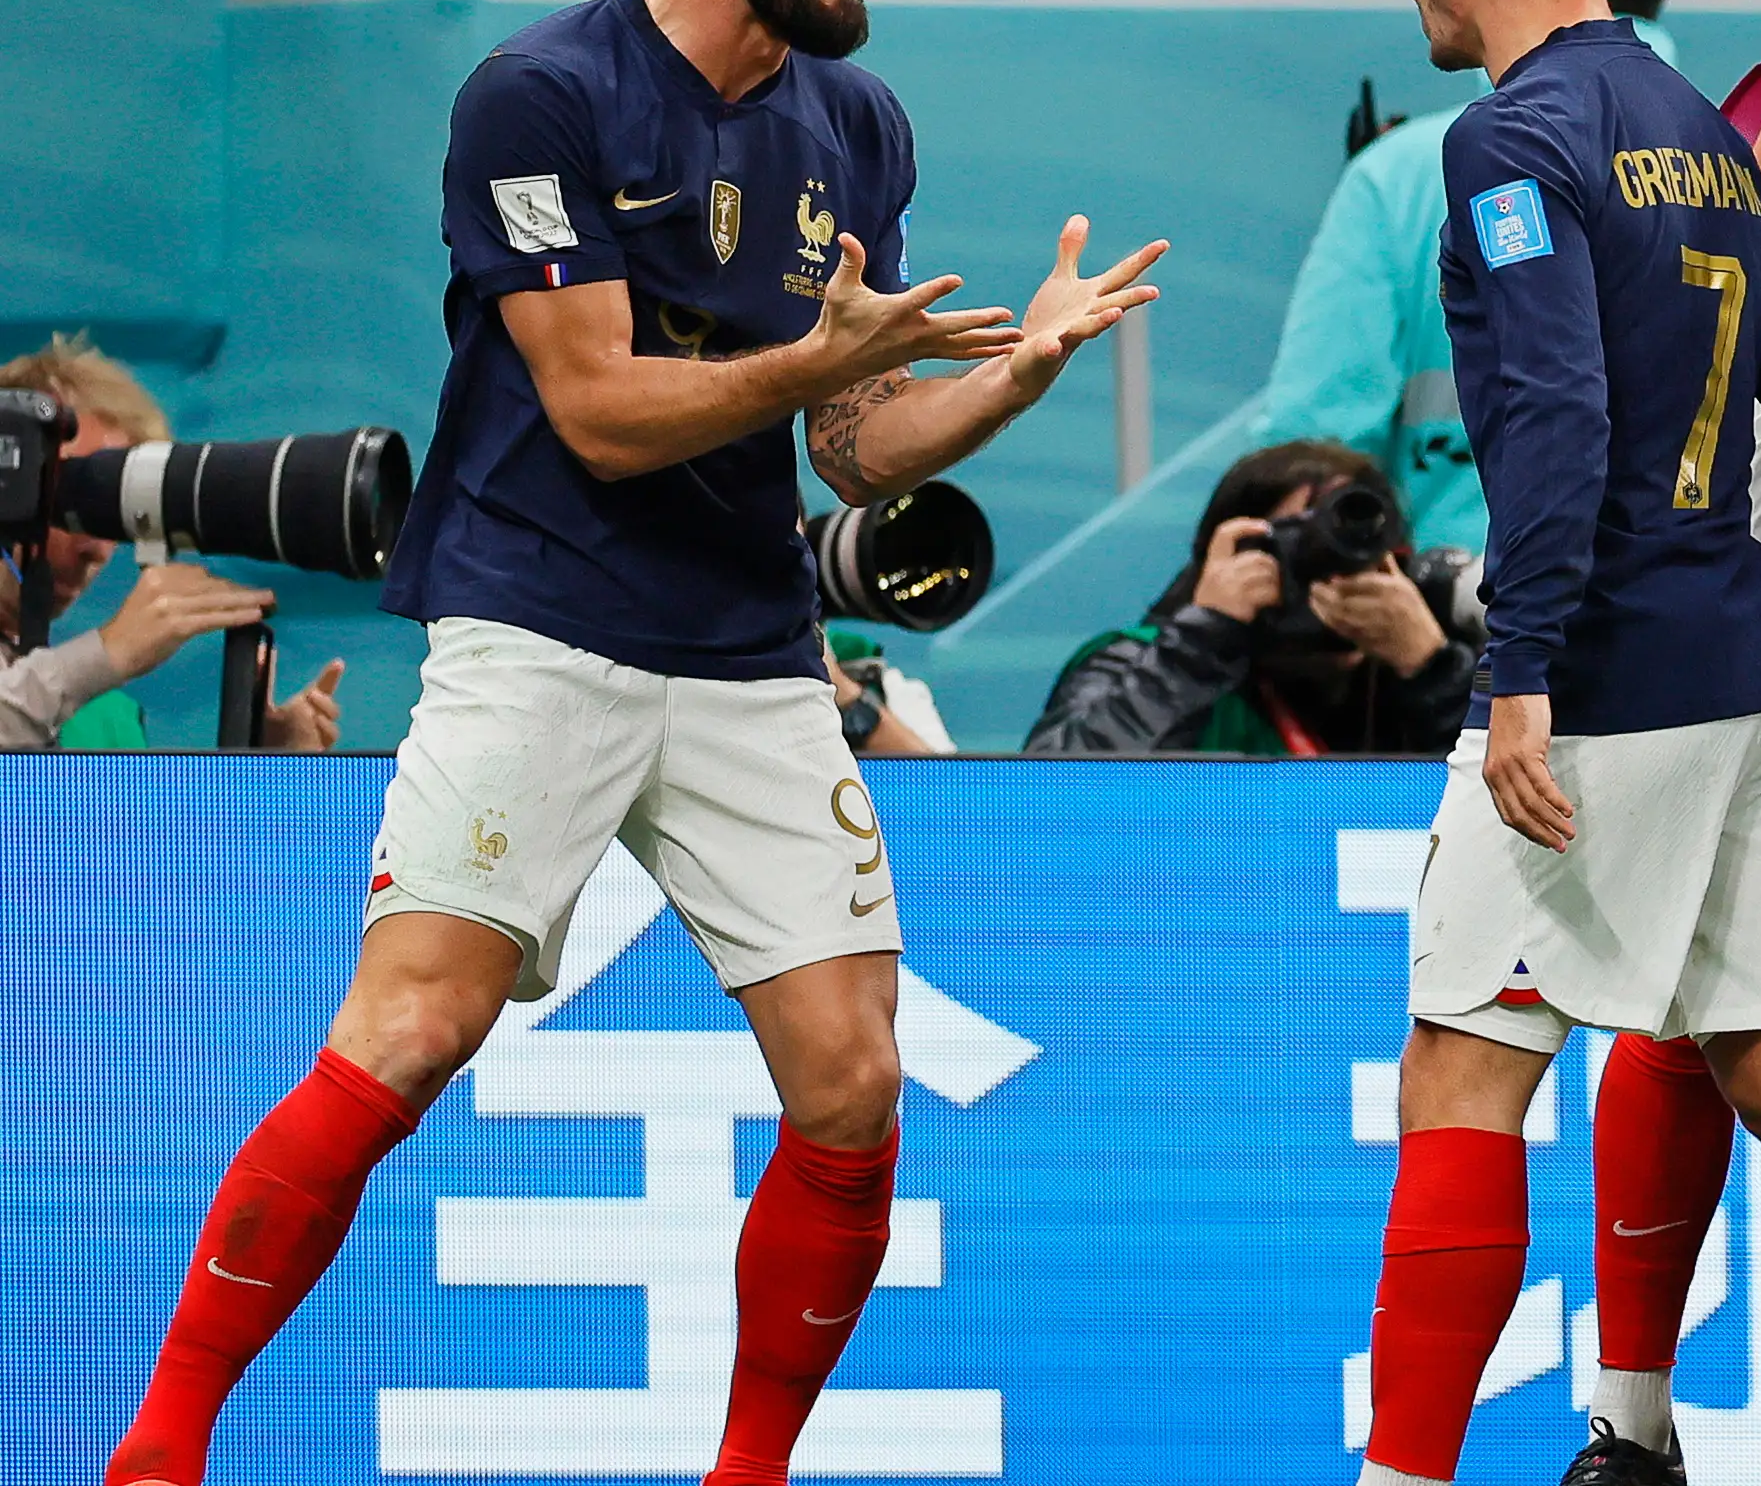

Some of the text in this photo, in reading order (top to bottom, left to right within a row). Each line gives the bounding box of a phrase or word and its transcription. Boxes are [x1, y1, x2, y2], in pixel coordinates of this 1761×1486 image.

[658, 302, 720, 360] 9
[1673, 244, 1747, 511] 7
[831, 778, 883, 877] 9
